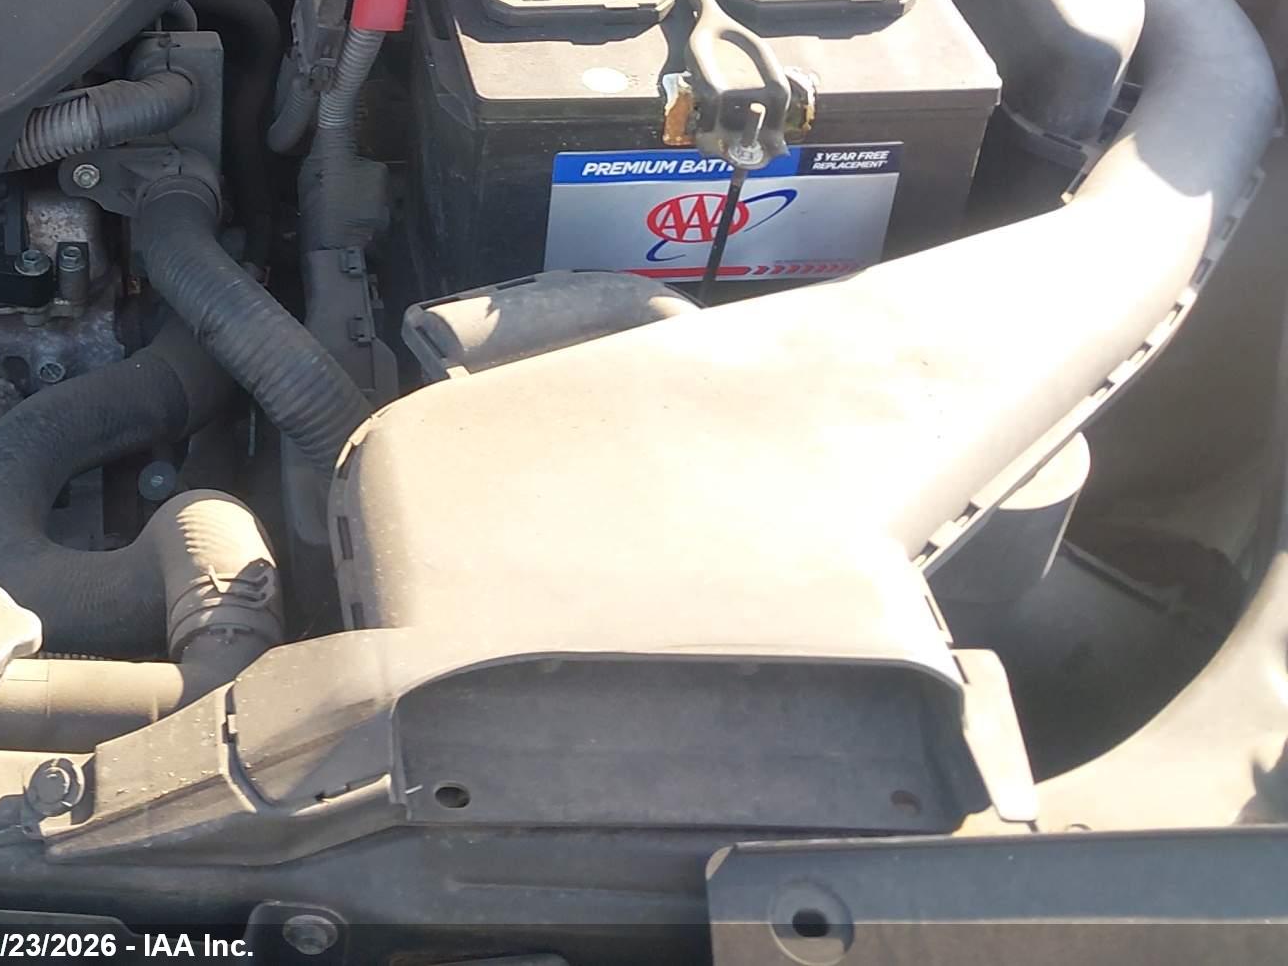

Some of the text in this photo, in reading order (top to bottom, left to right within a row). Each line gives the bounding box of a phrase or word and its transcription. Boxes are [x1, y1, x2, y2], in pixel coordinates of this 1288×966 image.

[814, 149, 891, 162] 3 YEAR FREE
[581, 158, 735, 177] PREMIUM BATT
